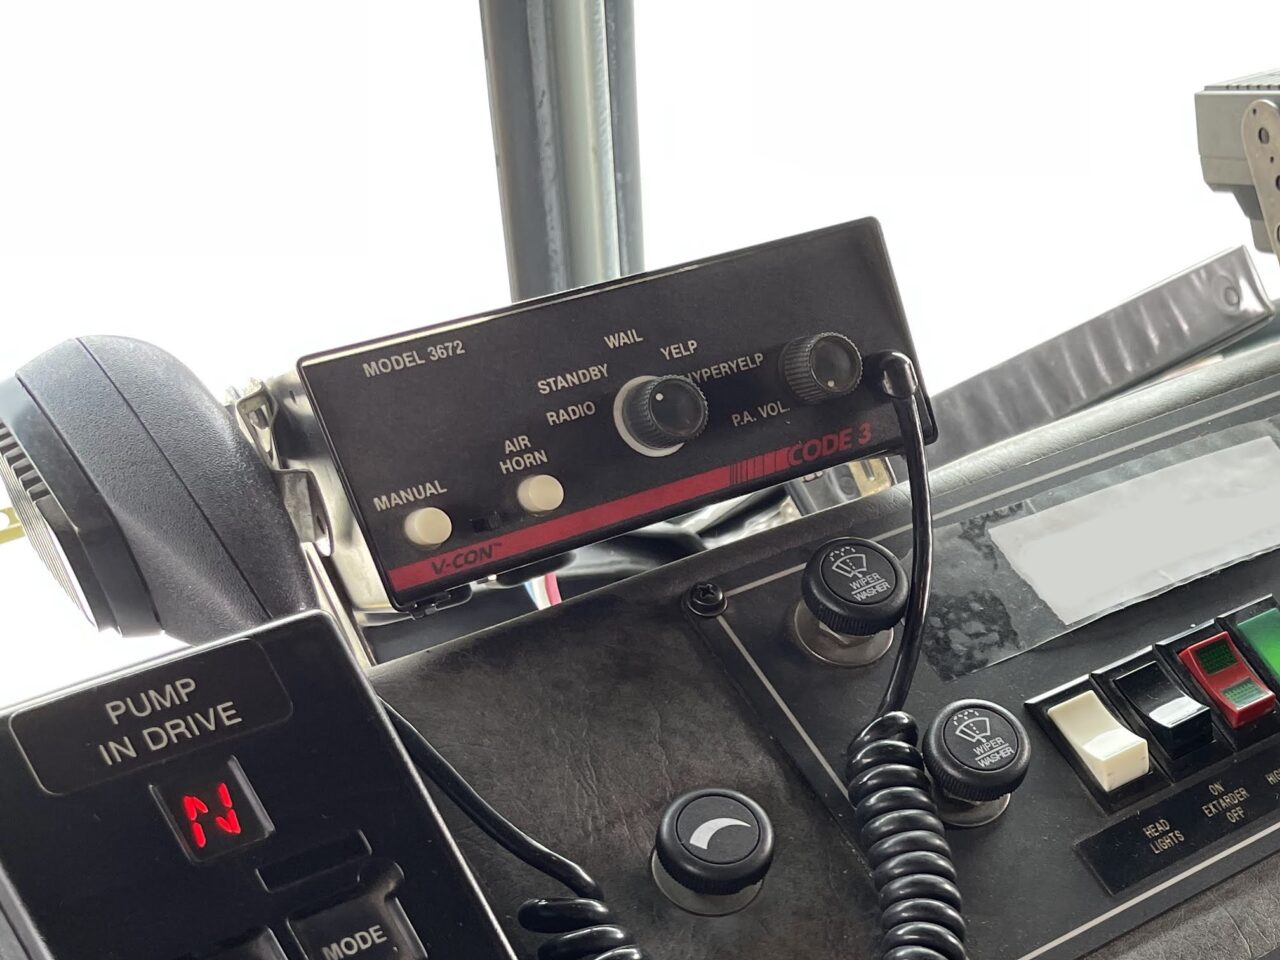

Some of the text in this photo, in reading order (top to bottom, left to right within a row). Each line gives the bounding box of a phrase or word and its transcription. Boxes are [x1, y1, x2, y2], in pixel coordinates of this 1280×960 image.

[604, 328, 644, 350] WAIL
[660, 339, 698, 360] YELP
[363, 340, 465, 378] MODEL 3672
[537, 363, 609, 396] STANDBY
[546, 401, 596, 427] RADIO
[731, 401, 791, 427] P.A. VOL.
[504, 434, 531, 454] AIR
[788, 421, 872, 466] CODE 3
[500, 450, 548, 474] HORN
[373, 480, 447, 512] MANUAL
[849, 572, 882, 590] WIPER
[853, 581, 891, 602] WASHER
[105, 677, 197, 725] PUMP
[99, 701, 242, 766] IN DRIVE
[973, 736, 1005, 755] WIPER
[977, 746, 1015, 767] WASHER
[1208, 783, 1223, 797] ON
[1202, 787, 1250, 818] EXTARDER
[182, 782, 241, 848] N
[1226, 807, 1246, 824] OFF
[1143, 818, 1171, 839] HEAD
[1150, 830, 1185, 855] LIGHTS
